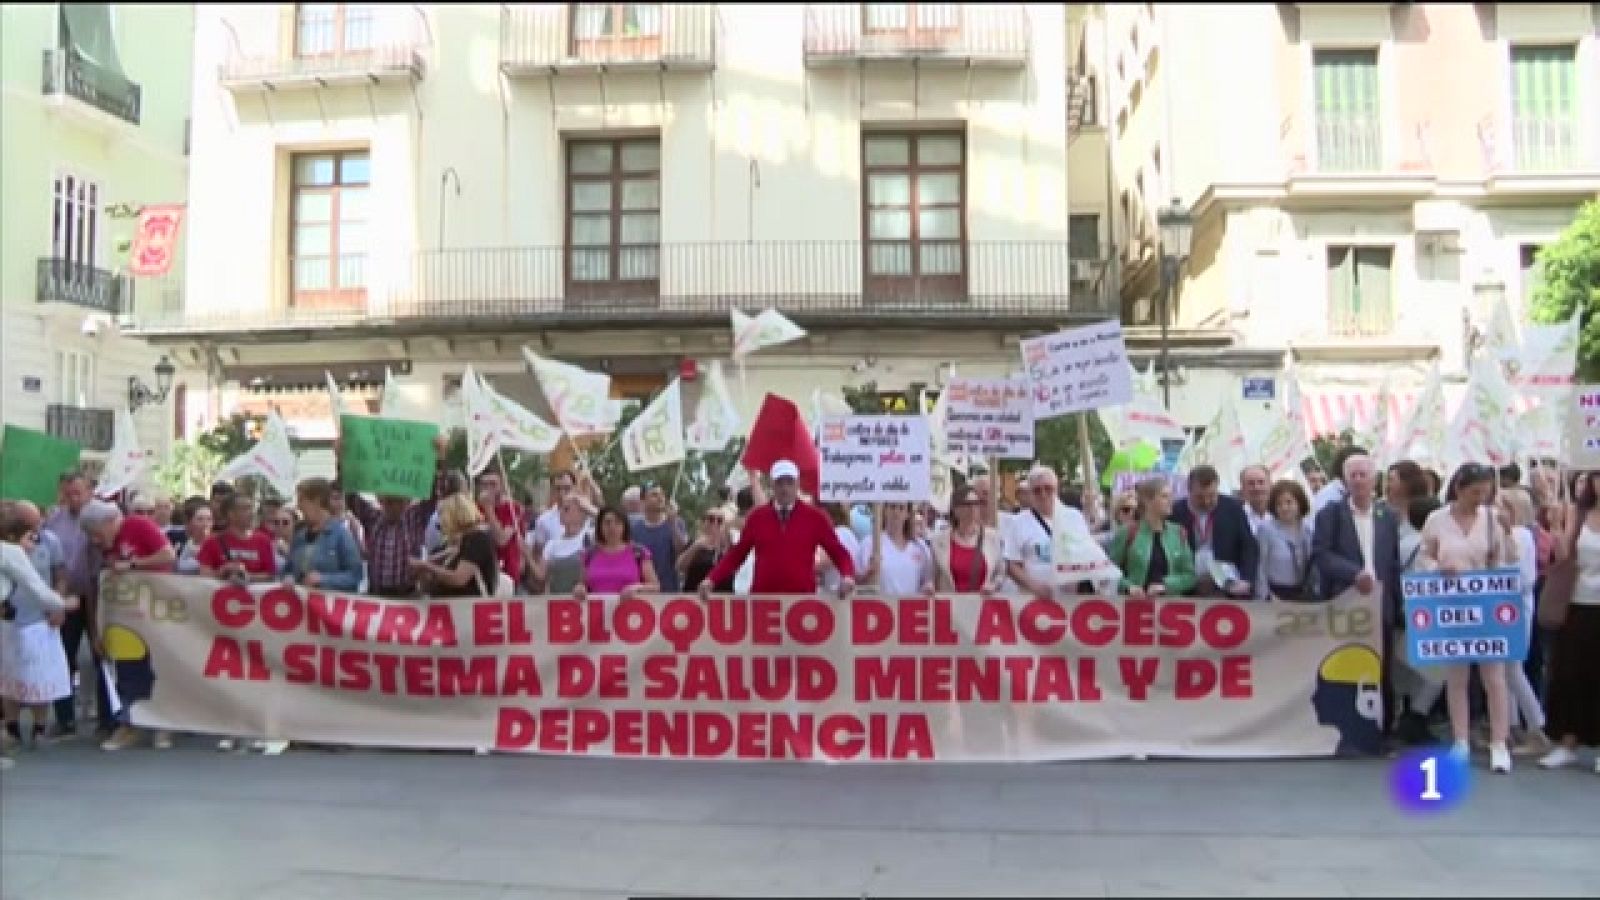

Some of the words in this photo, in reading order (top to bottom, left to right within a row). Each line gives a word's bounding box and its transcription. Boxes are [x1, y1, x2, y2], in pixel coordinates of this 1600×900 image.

[1404, 576, 1519, 596] DESPLOME
[211, 587, 457, 647] CONTRA
[473, 601, 533, 646] EL
[548, 599, 835, 655] BLOQUEO
[851, 600, 960, 646] DEL
[975, 600, 1250, 647] ACCESO
[1440, 608, 1480, 624] DEL
[1421, 639, 1505, 656] SECTOR
[204, 636, 270, 681] AL
[284, 644, 540, 699] SISTEMA
[558, 655, 628, 700] DE
[644, 655, 836, 703] SALUD
[855, 657, 1102, 703] MENTAL
[1119, 659, 1153, 702] Y
[1176, 660, 1253, 700] DE
[496, 708, 934, 761] DEPENDENCIA
